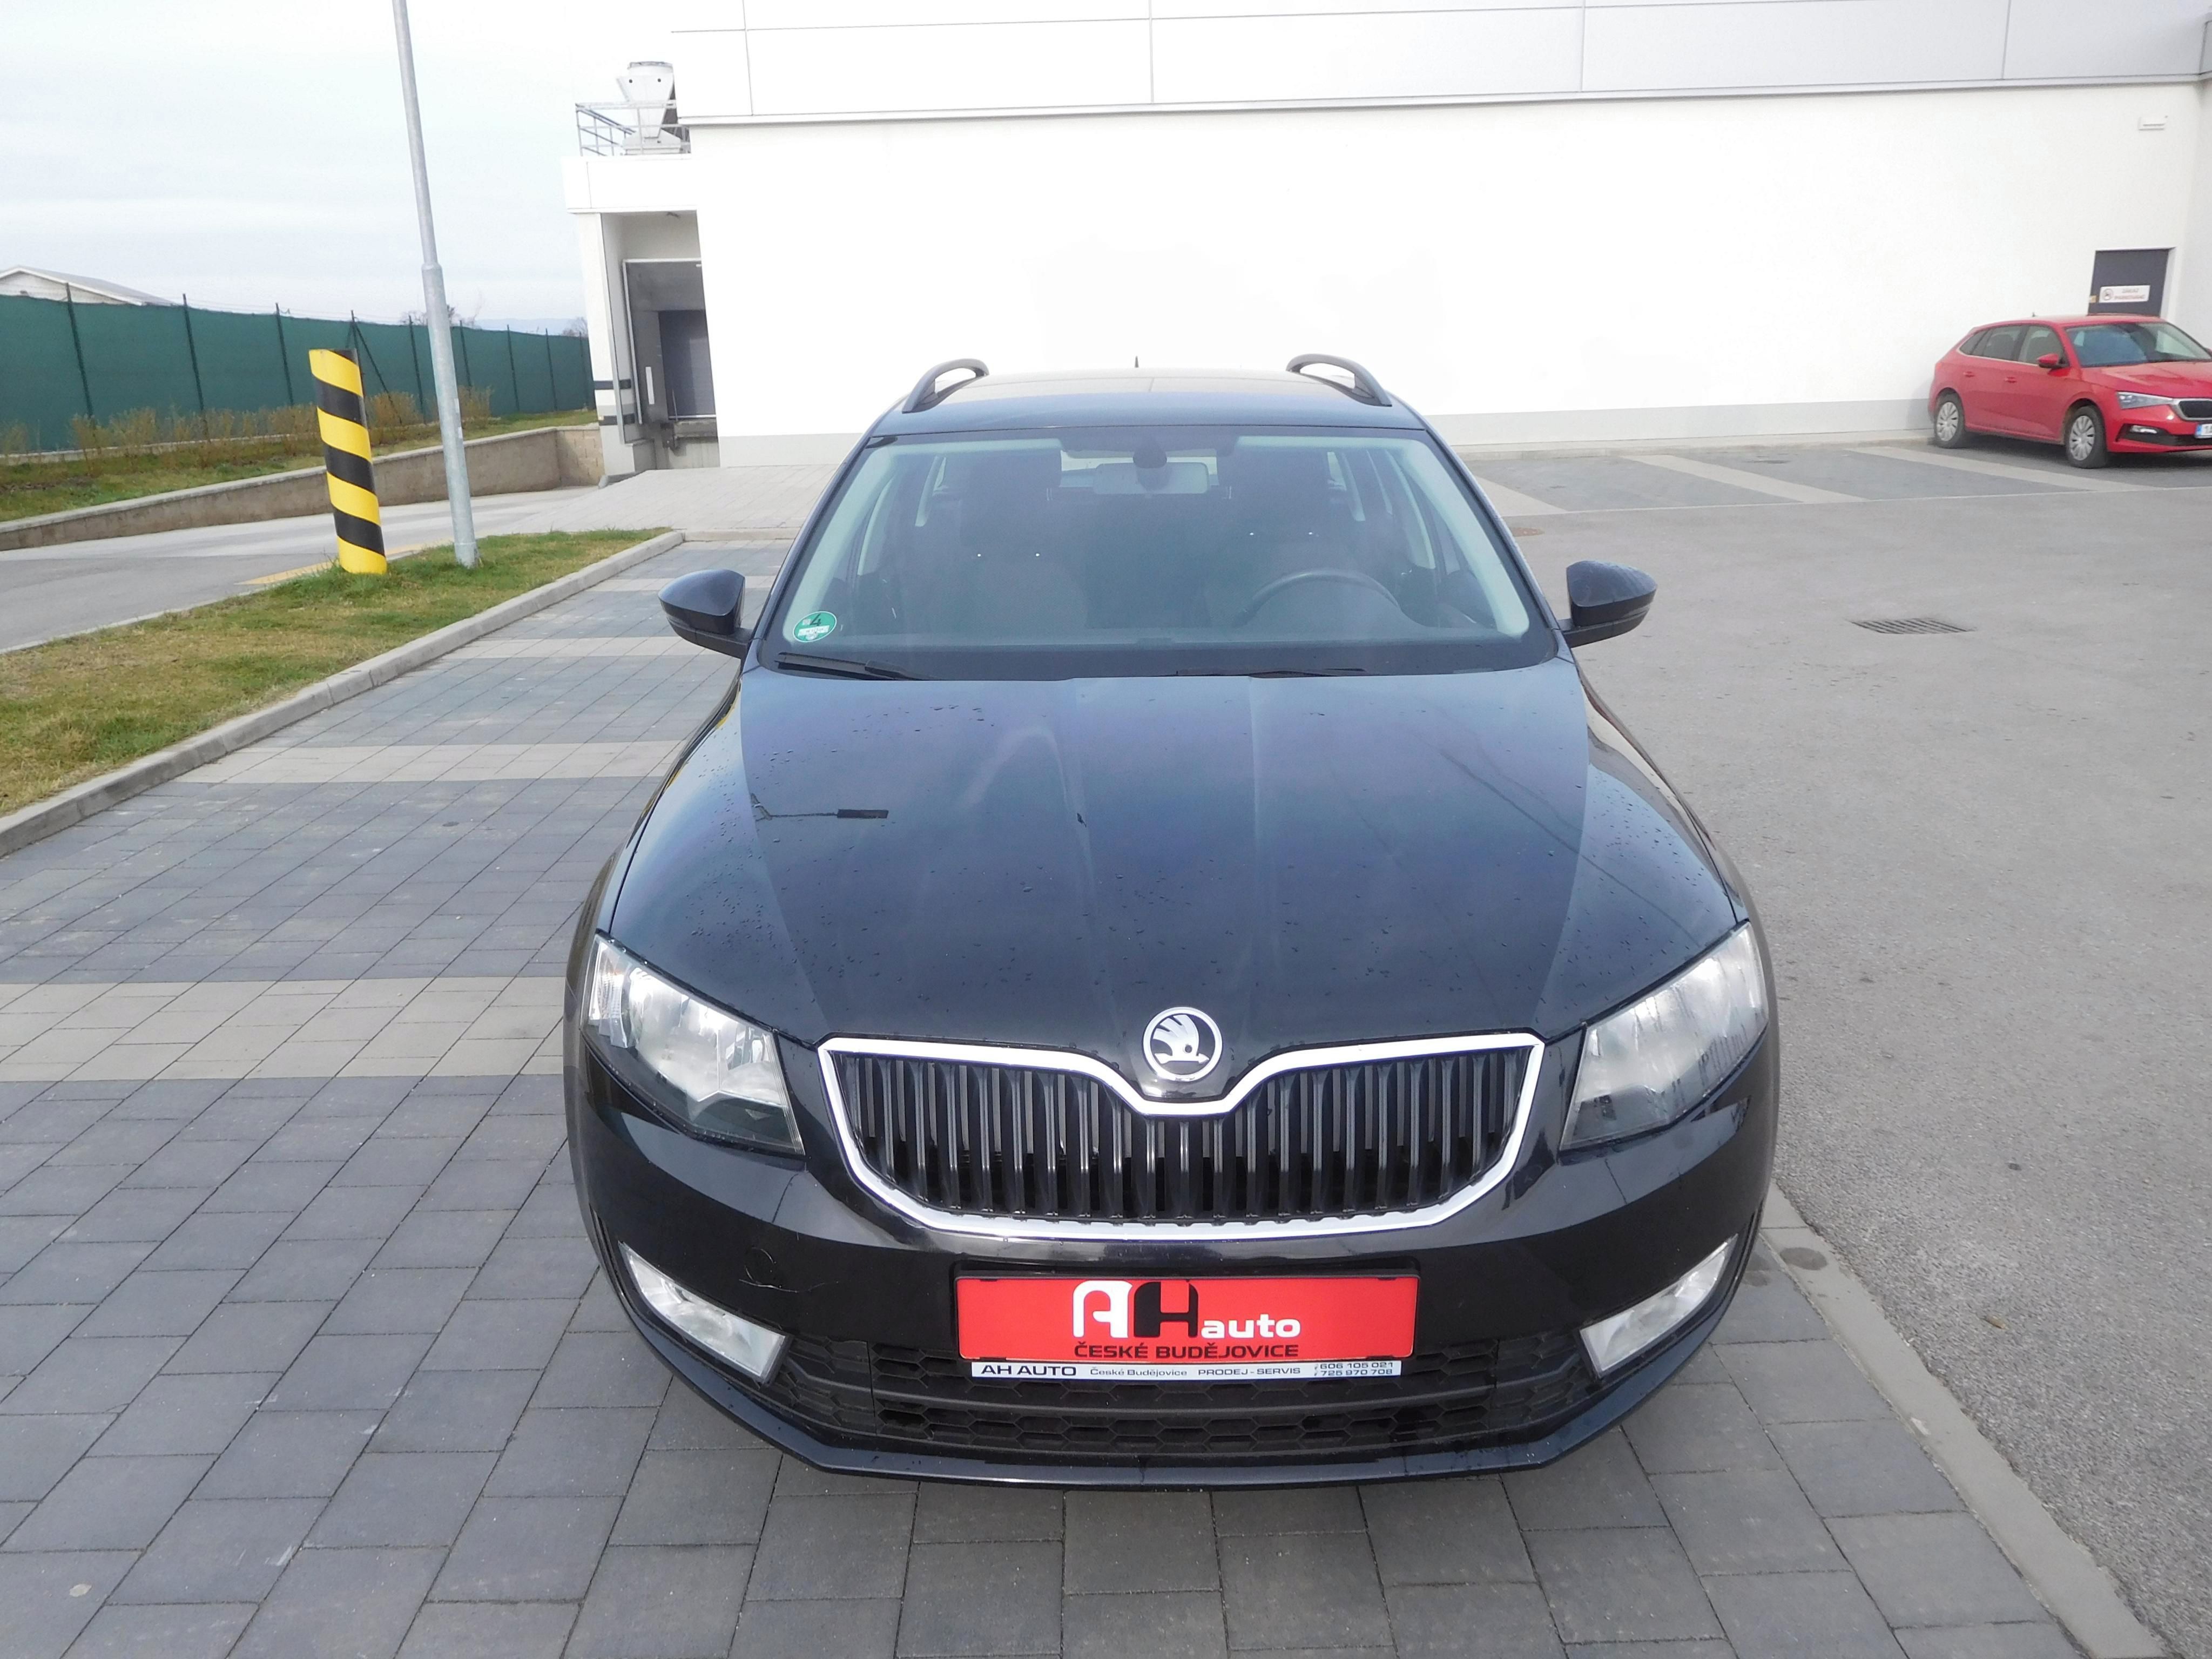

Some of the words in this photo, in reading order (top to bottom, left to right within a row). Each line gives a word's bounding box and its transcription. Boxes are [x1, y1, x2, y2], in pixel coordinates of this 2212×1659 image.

[810, 613, 821, 626] 4
[1201, 1314, 1301, 1338] auto
[1074, 1341, 1148, 1359] ČESKÉ
[1156, 1342, 1299, 1359] BUDĚJOVICE
[981, 1365, 1011, 1374] AH
[1017, 1366, 1076, 1376] AUTO
[1090, 1367, 1124, 1375] České
